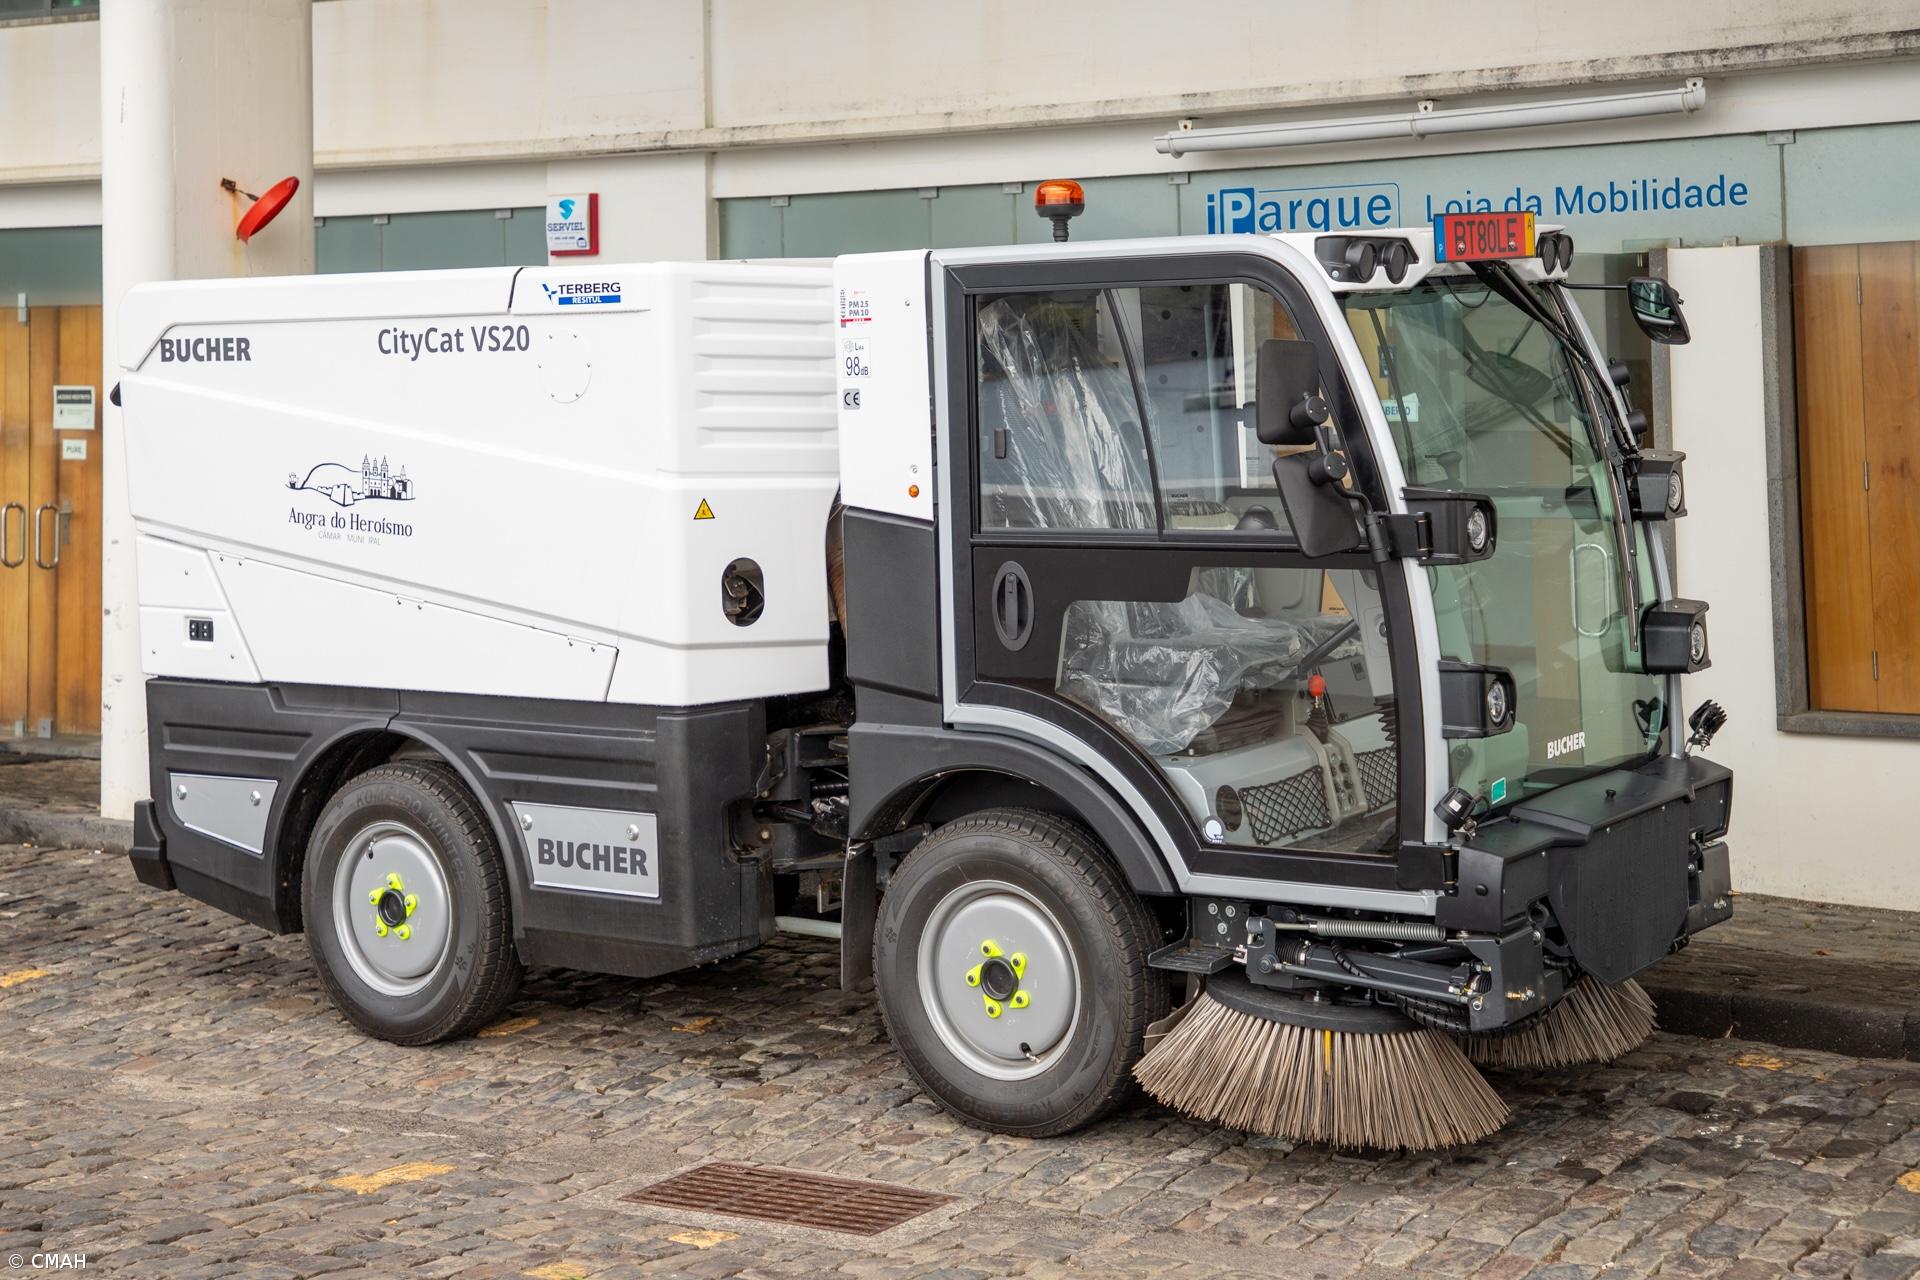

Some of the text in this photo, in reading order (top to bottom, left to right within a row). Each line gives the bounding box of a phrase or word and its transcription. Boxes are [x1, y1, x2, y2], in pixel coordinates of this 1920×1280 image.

[1504, 187, 1543, 215] da
[1555, 175, 1748, 216] Mobilidade
[1207, 189, 1392, 234] iParque
[1527, 218, 1533, 230] A
[547, 222, 585, 232] SERVIEL
[1454, 218, 1518, 256] BT80LE
[558, 282, 622, 295] TERBERG
[572, 296, 602, 304] RESITUL
[848, 301, 859, 309] PM
[860, 309, 869, 317] 10
[160, 337, 251, 362] BUCHER
[378, 325, 530, 361] CityCat VS20
[288, 506, 413, 537] Angra do Heroísmo
[1546, 731, 1586, 759] BUCHER
[537, 837, 648, 877] BUCHER
